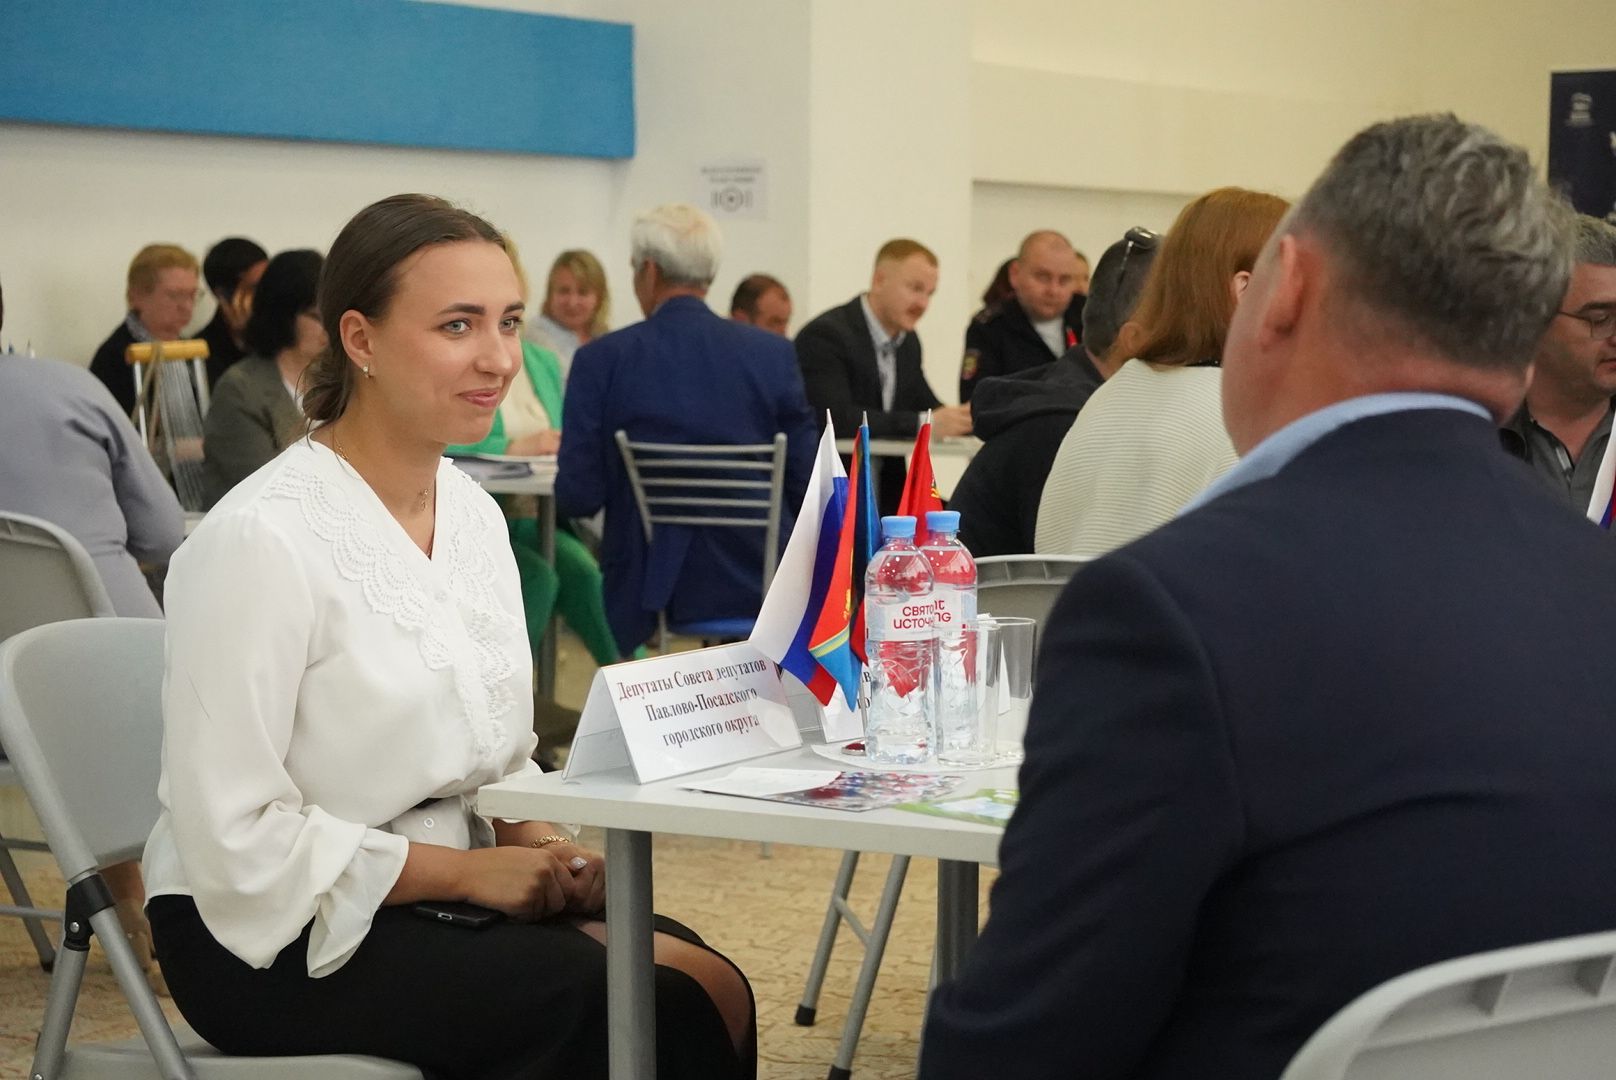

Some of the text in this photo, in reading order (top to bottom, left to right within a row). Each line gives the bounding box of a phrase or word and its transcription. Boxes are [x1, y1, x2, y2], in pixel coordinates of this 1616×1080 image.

[902, 604, 934, 617] СВЯТО
[616, 658, 767, 701] Депутаты Совета депутатов
[645, 686, 758, 722] Павлово-Посадского
[662, 713, 760, 749] городского округа
